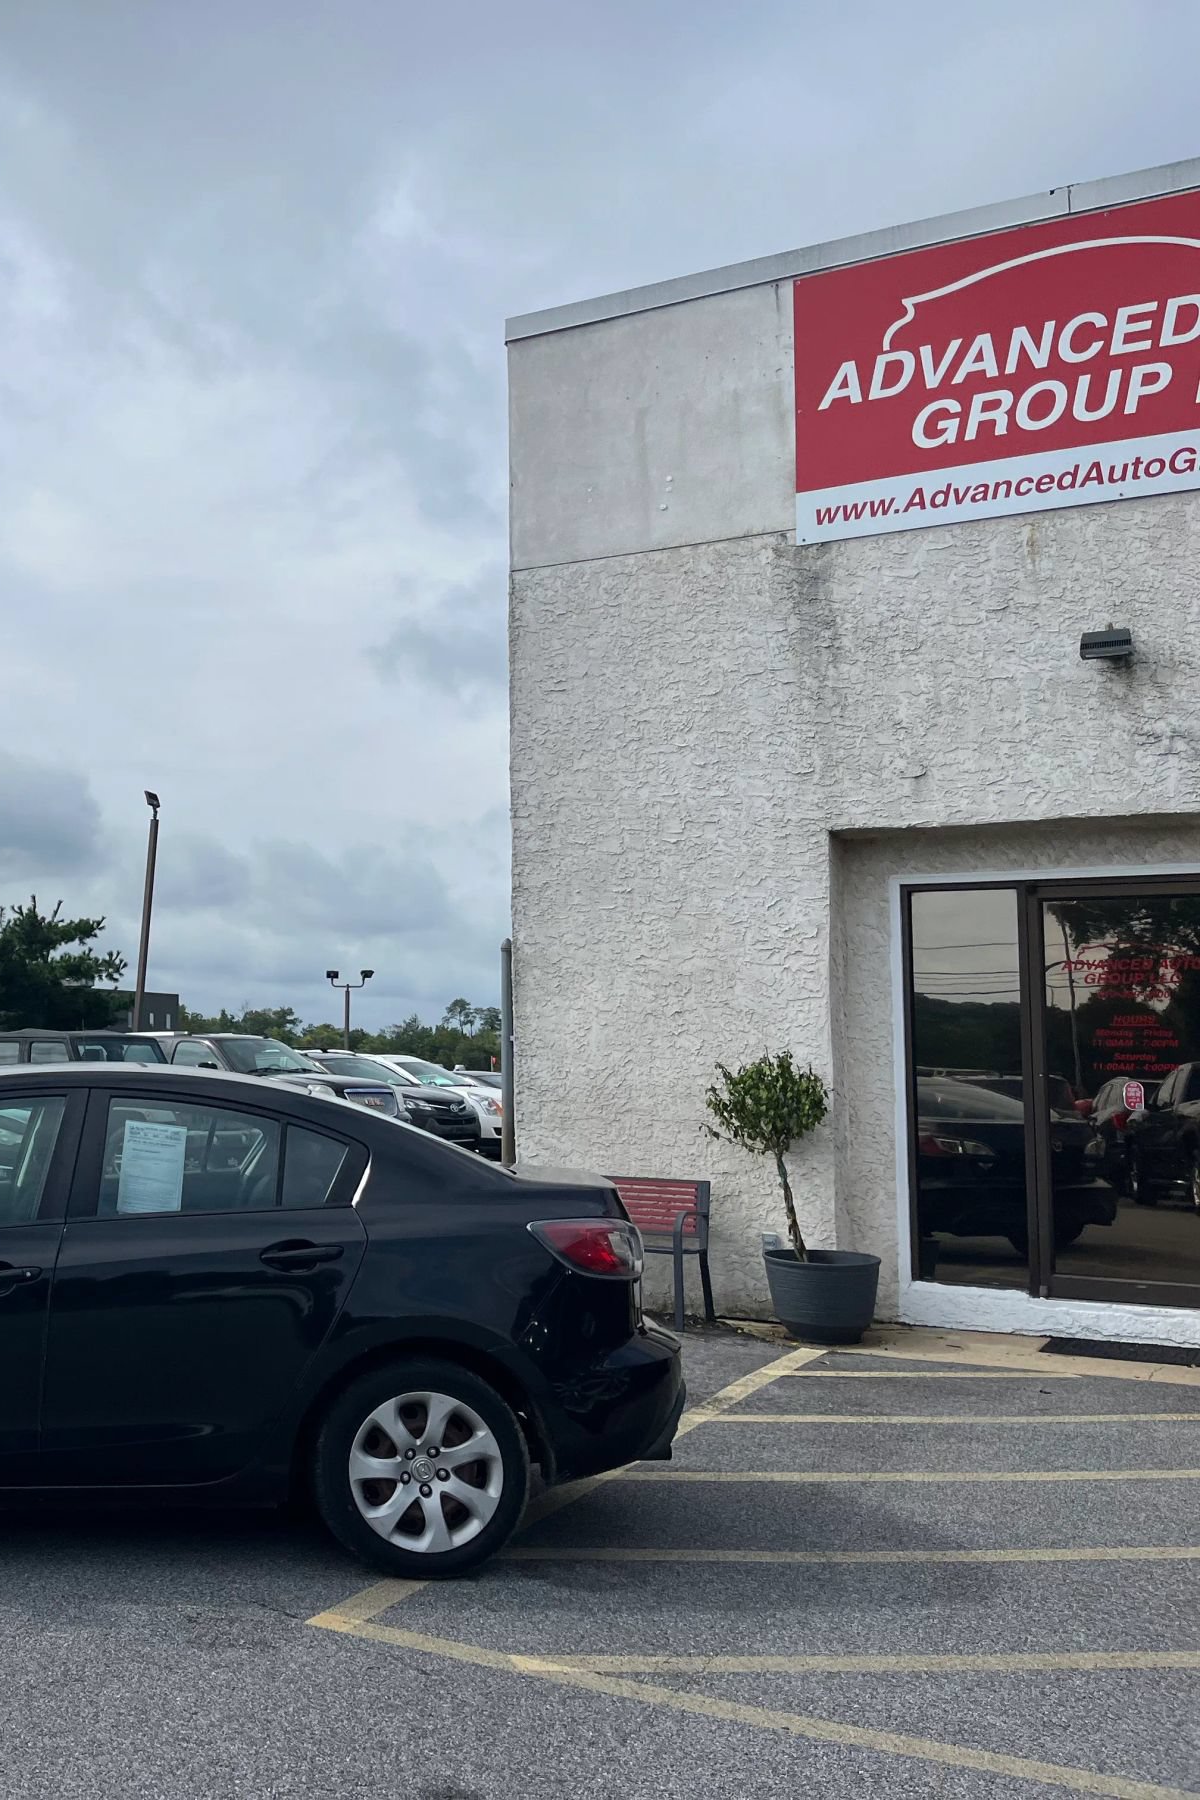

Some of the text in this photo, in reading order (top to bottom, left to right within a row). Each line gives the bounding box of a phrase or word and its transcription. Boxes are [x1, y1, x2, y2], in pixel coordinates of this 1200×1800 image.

[818, 294, 1200, 410] ADVANCED
[912, 363, 1172, 448] GROUP
[815, 447, 1200, 525] www.AdvancedAutoG
[1061, 959, 1153, 970] ADVANCED
[1084, 973, 1145, 985] GROUP
[1112, 1015, 1157, 1025] HOURS
[1096, 1028, 1134, 1038] Monday
[1144, 1029, 1173, 1038] Friday
[1114, 1053, 1157, 1062] Saturday
